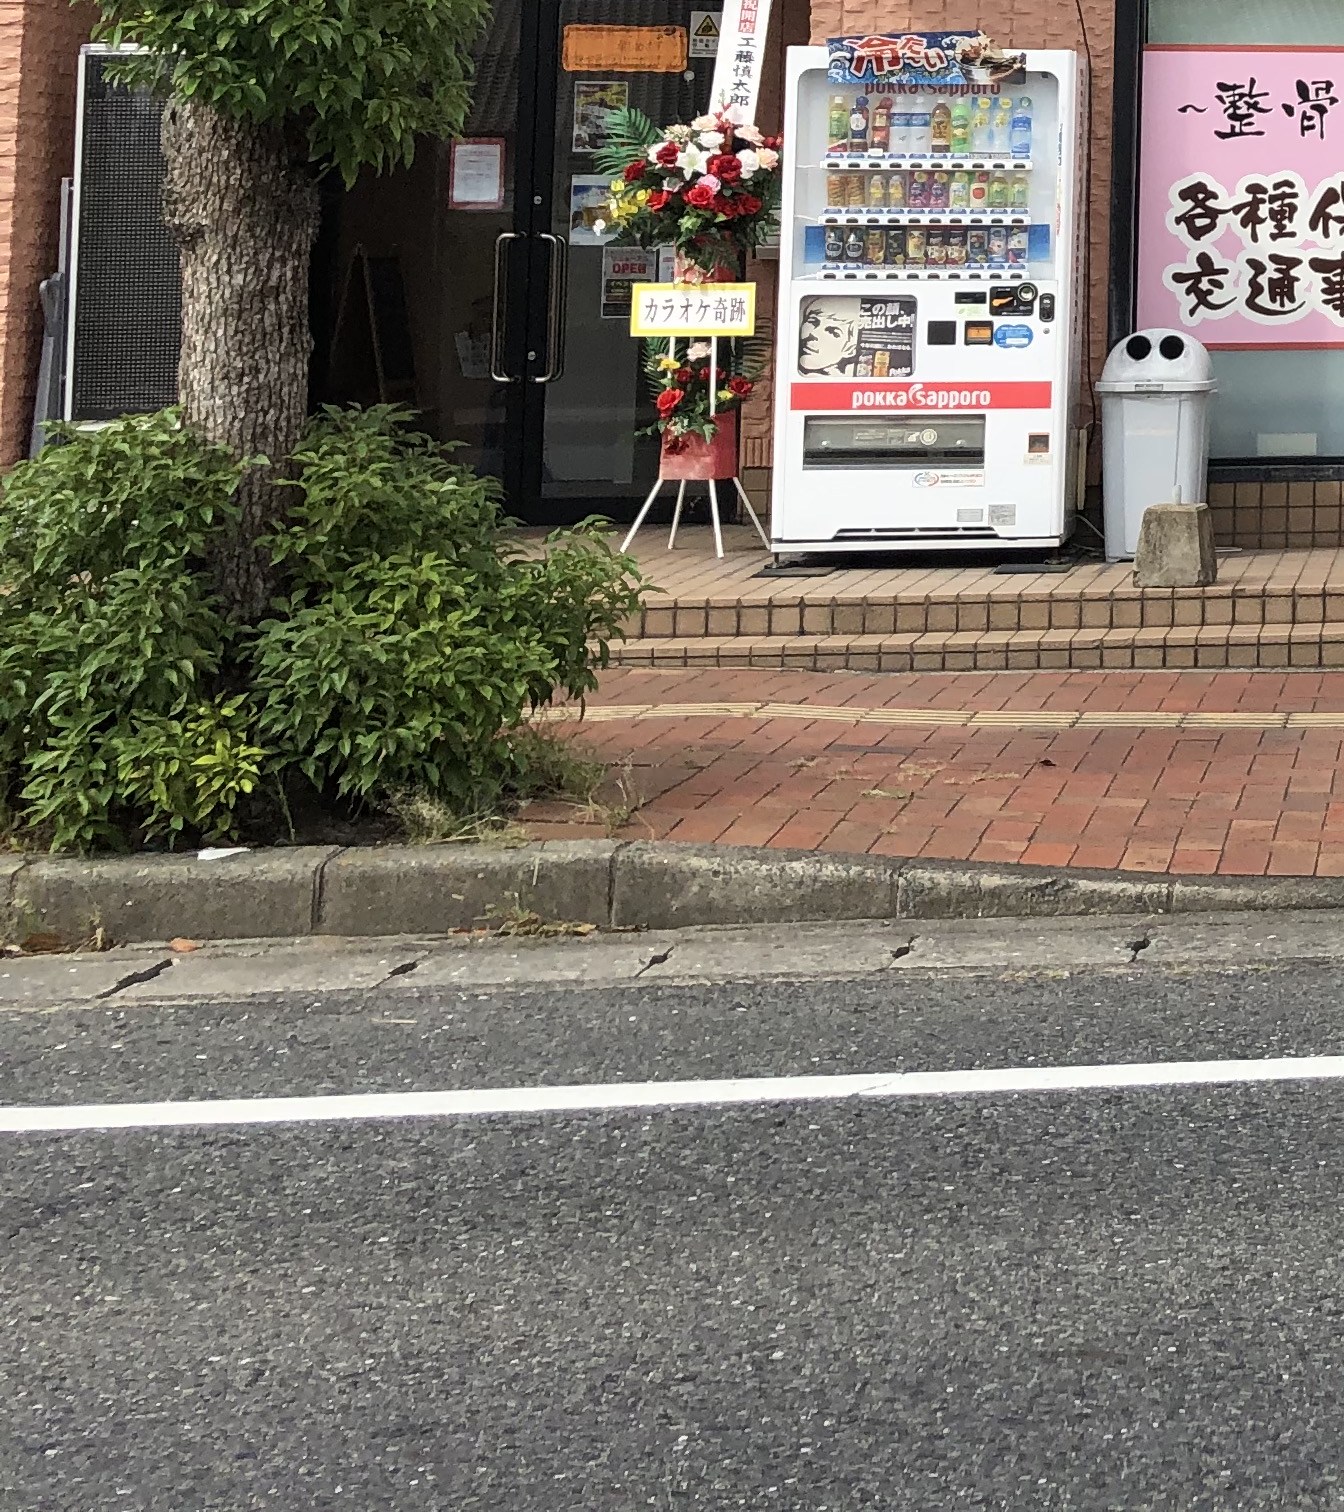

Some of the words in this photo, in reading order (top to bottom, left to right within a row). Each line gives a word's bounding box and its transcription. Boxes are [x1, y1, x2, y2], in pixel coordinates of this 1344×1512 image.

[844, 35, 947, 77] 冷たい
[644, 297, 746, 323] カラオケ奇跡
